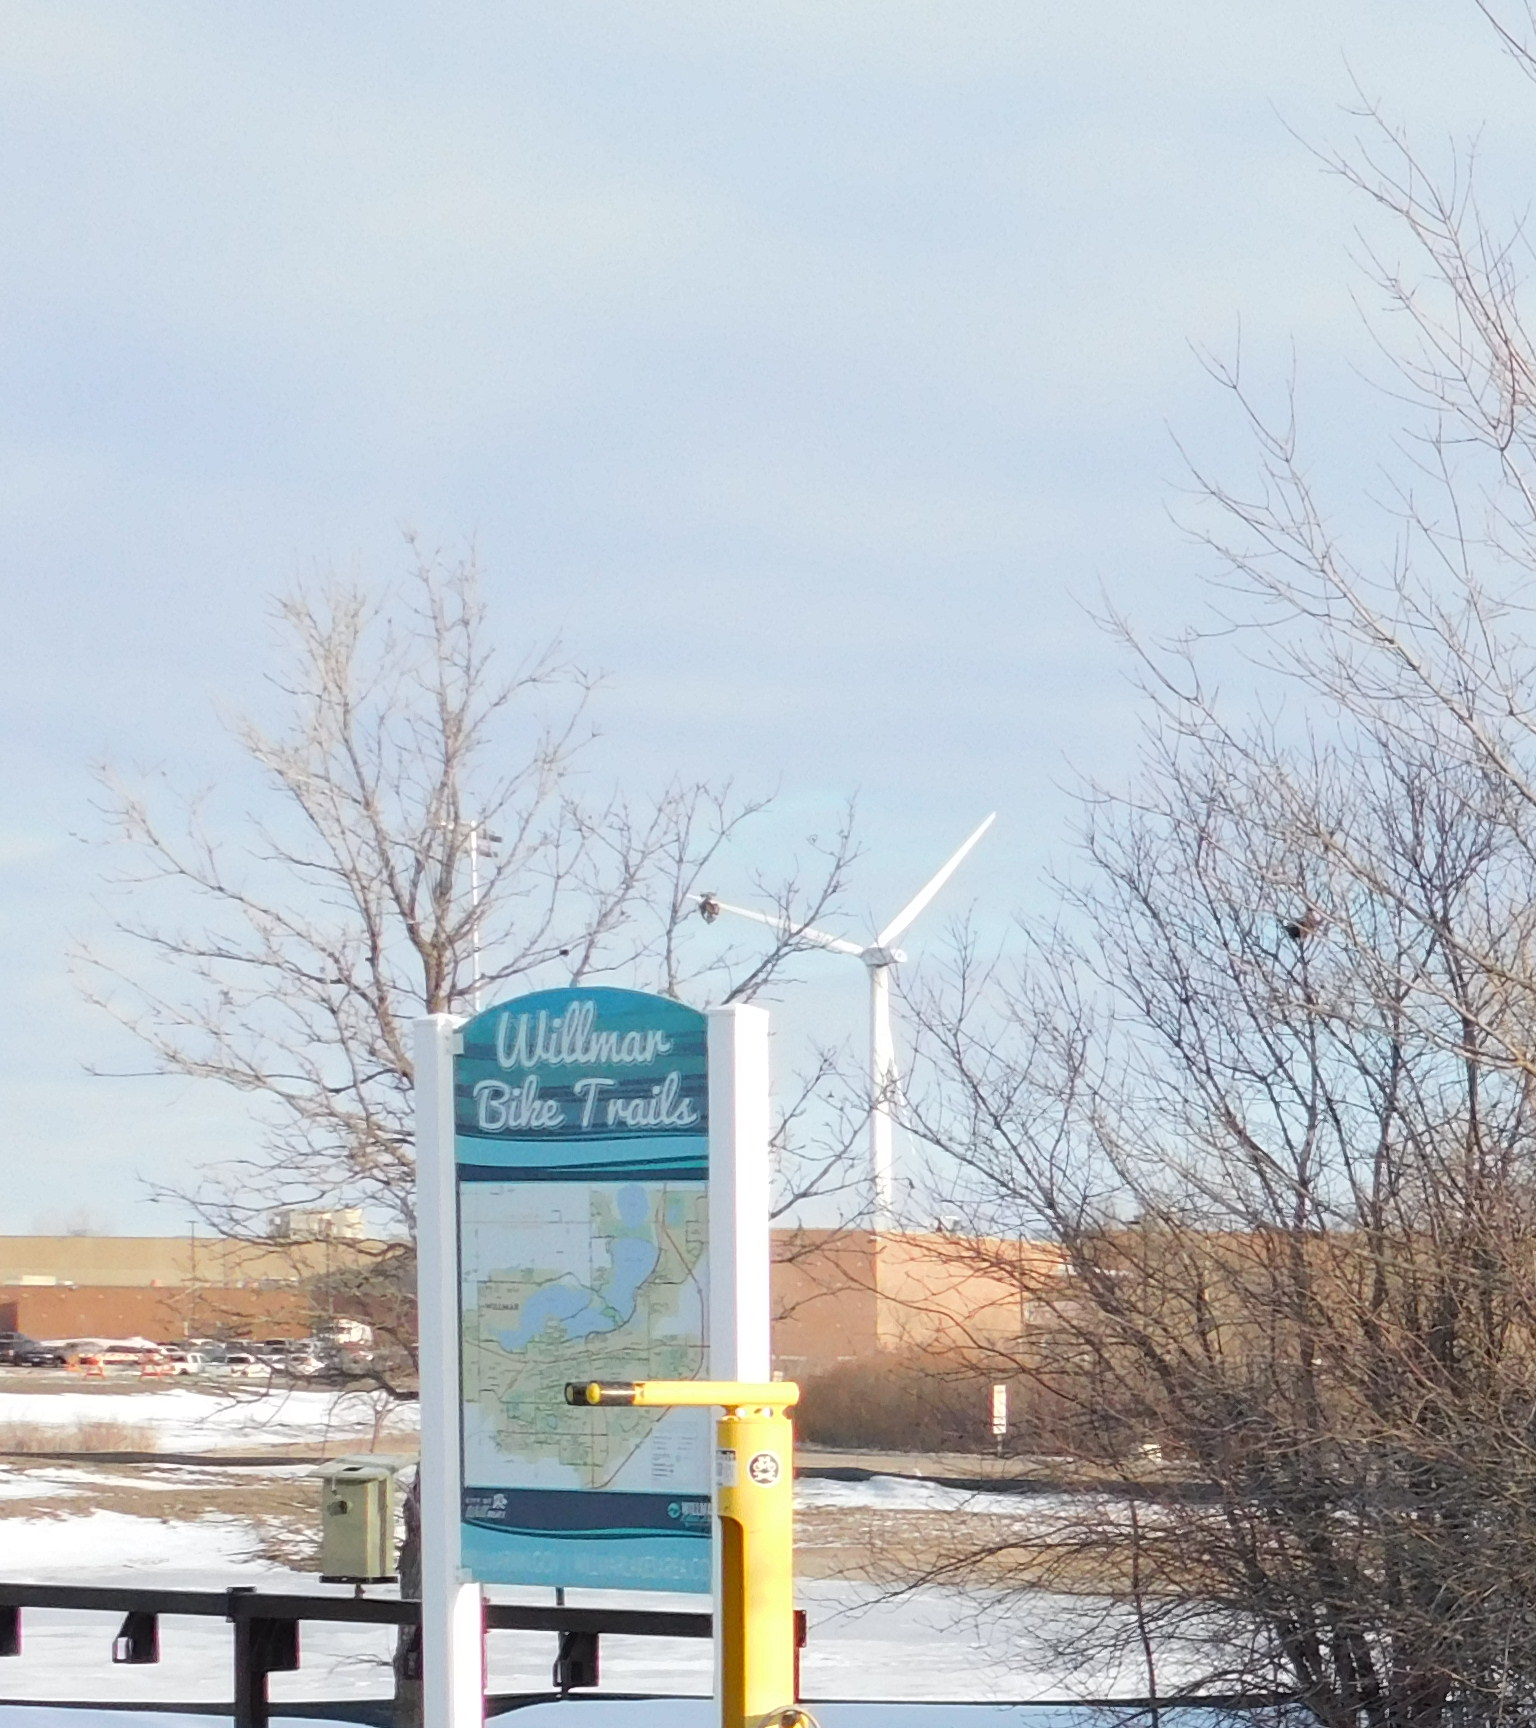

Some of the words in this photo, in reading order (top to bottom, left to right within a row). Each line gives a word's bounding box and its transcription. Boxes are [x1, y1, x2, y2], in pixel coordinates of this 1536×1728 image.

[494, 1000, 672, 1069] Willmar
[473, 1074, 566, 1132] Bike
[573, 1071, 698, 1131] Trails
